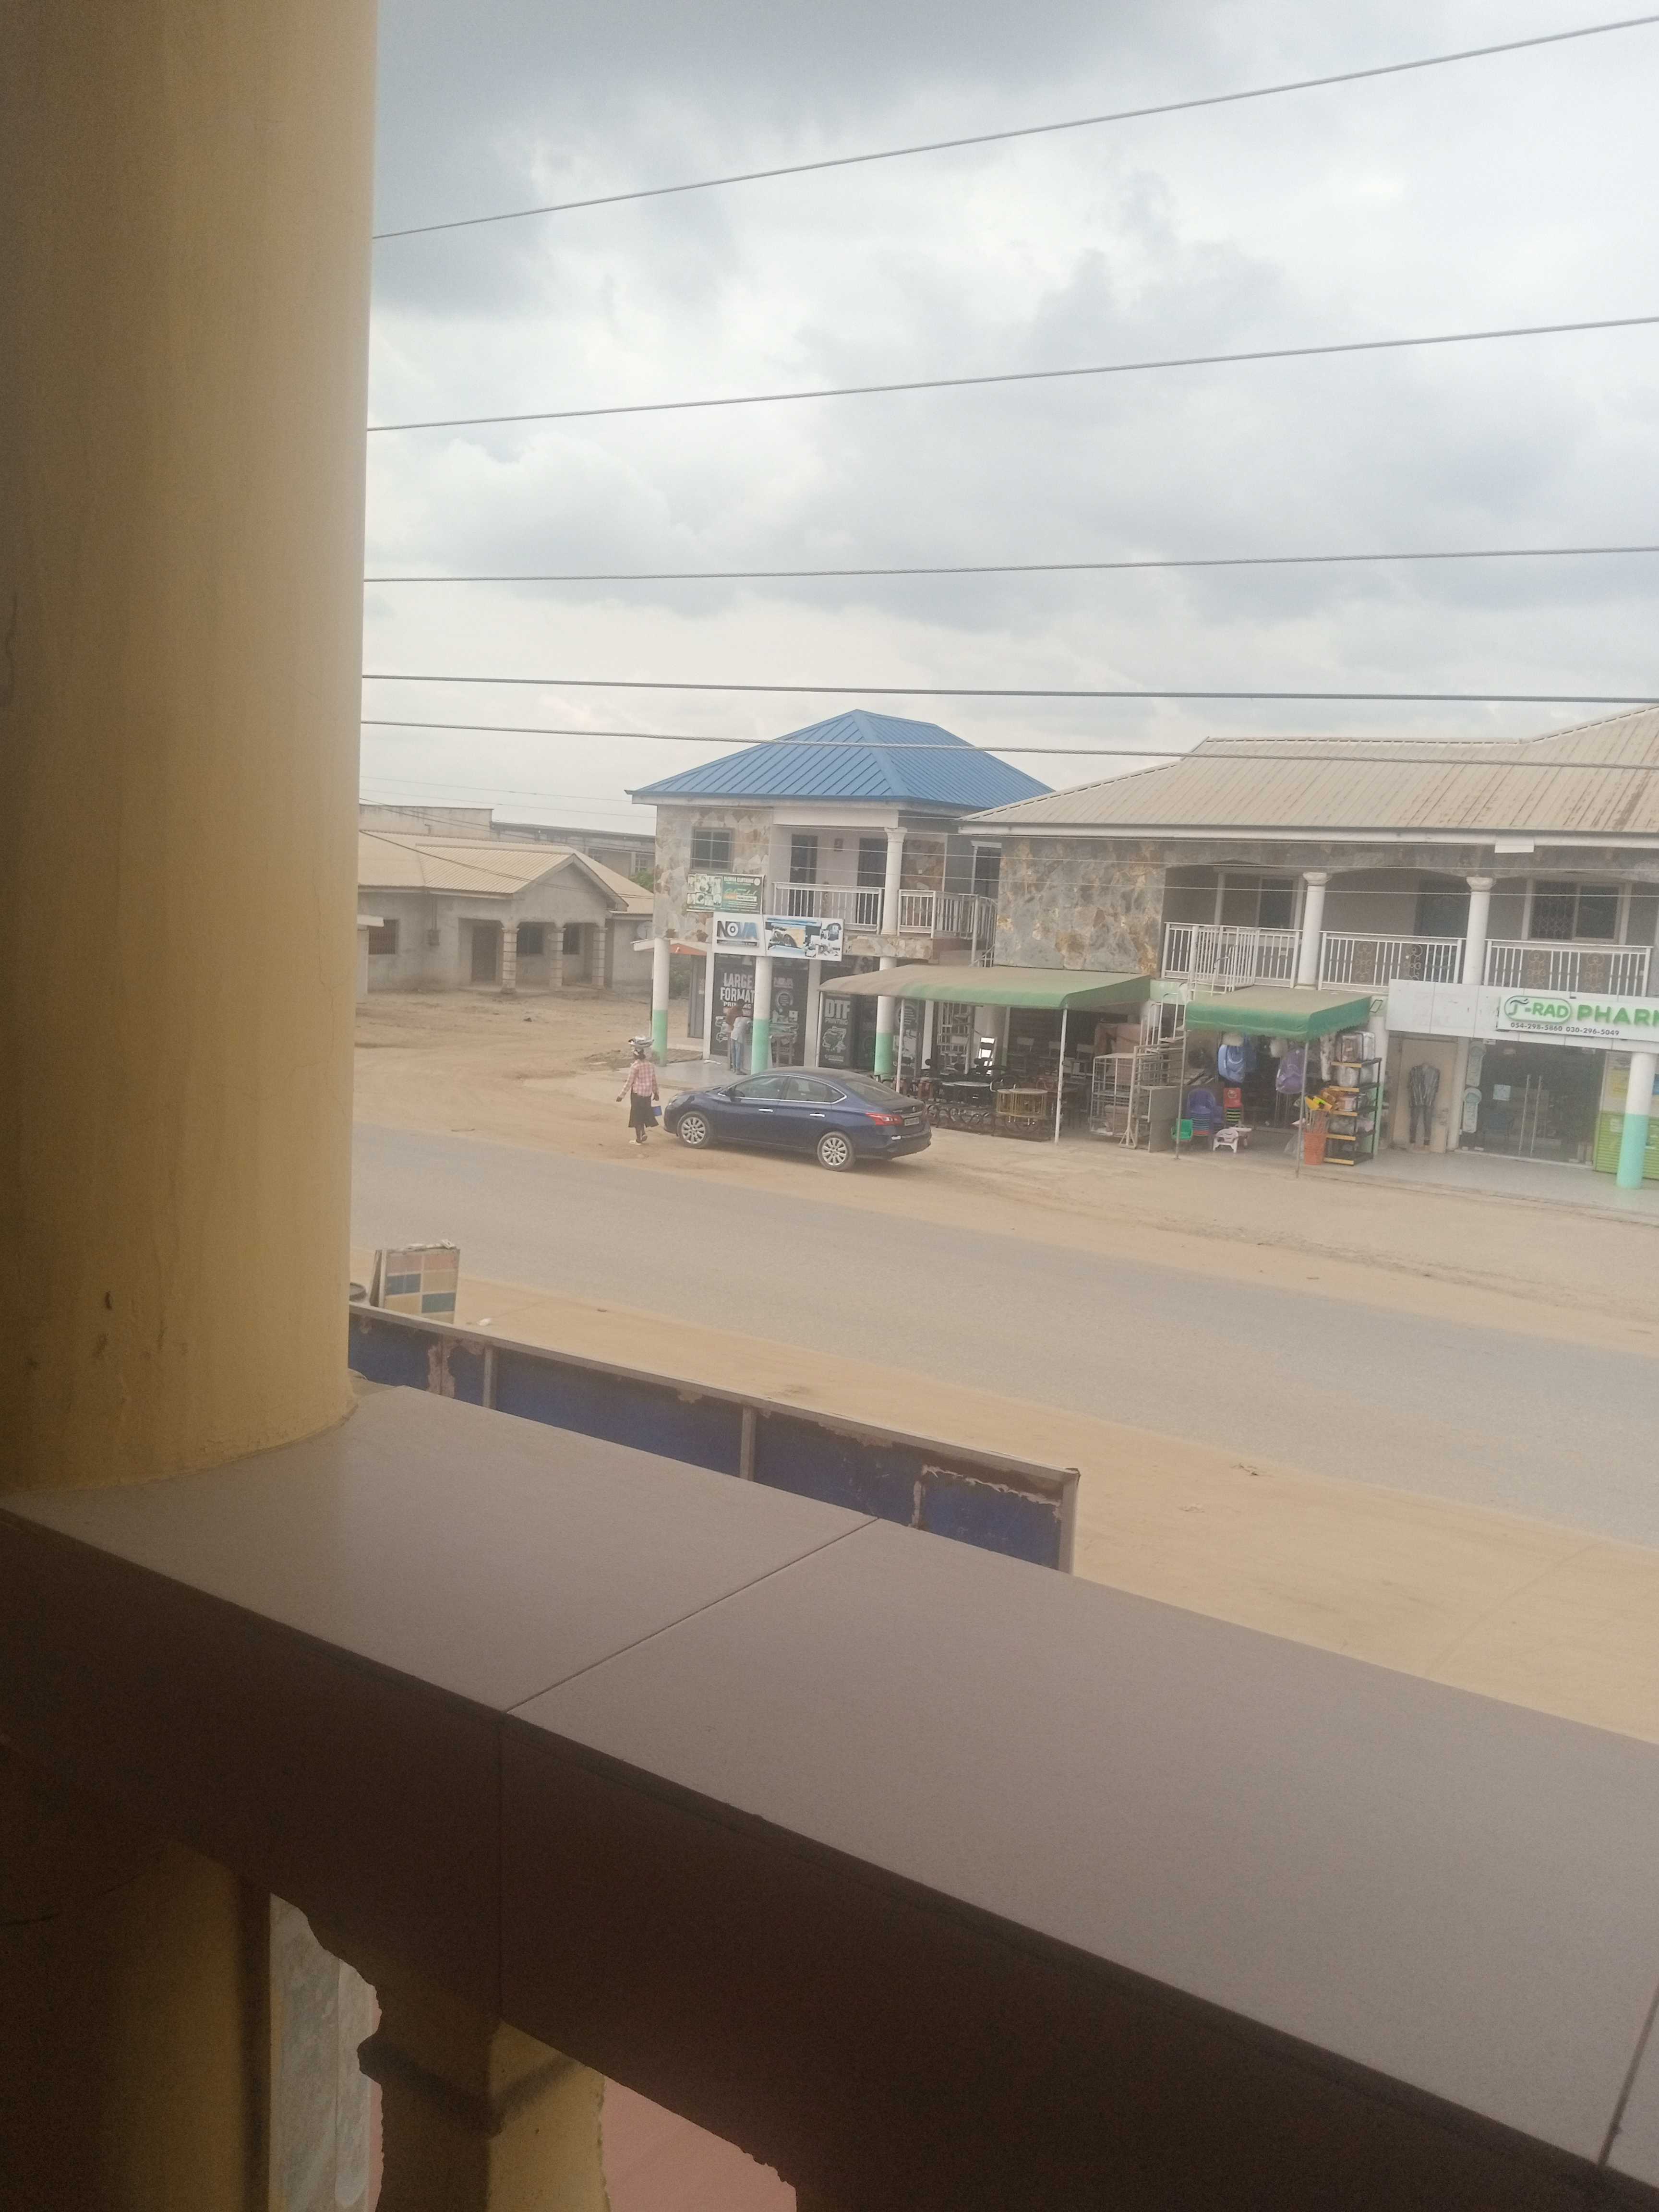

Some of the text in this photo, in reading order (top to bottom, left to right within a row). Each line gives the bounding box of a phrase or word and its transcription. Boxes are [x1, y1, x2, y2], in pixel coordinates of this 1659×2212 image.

[723, 973, 753, 989] LARGE
[720, 987, 755, 1003] FORMAT
[824, 998, 851, 1019] DTF
[824, 1017, 849, 1025] PRINTING
[1510, 1022, 1620, 1036] 054-298-5860 030-296-5049
